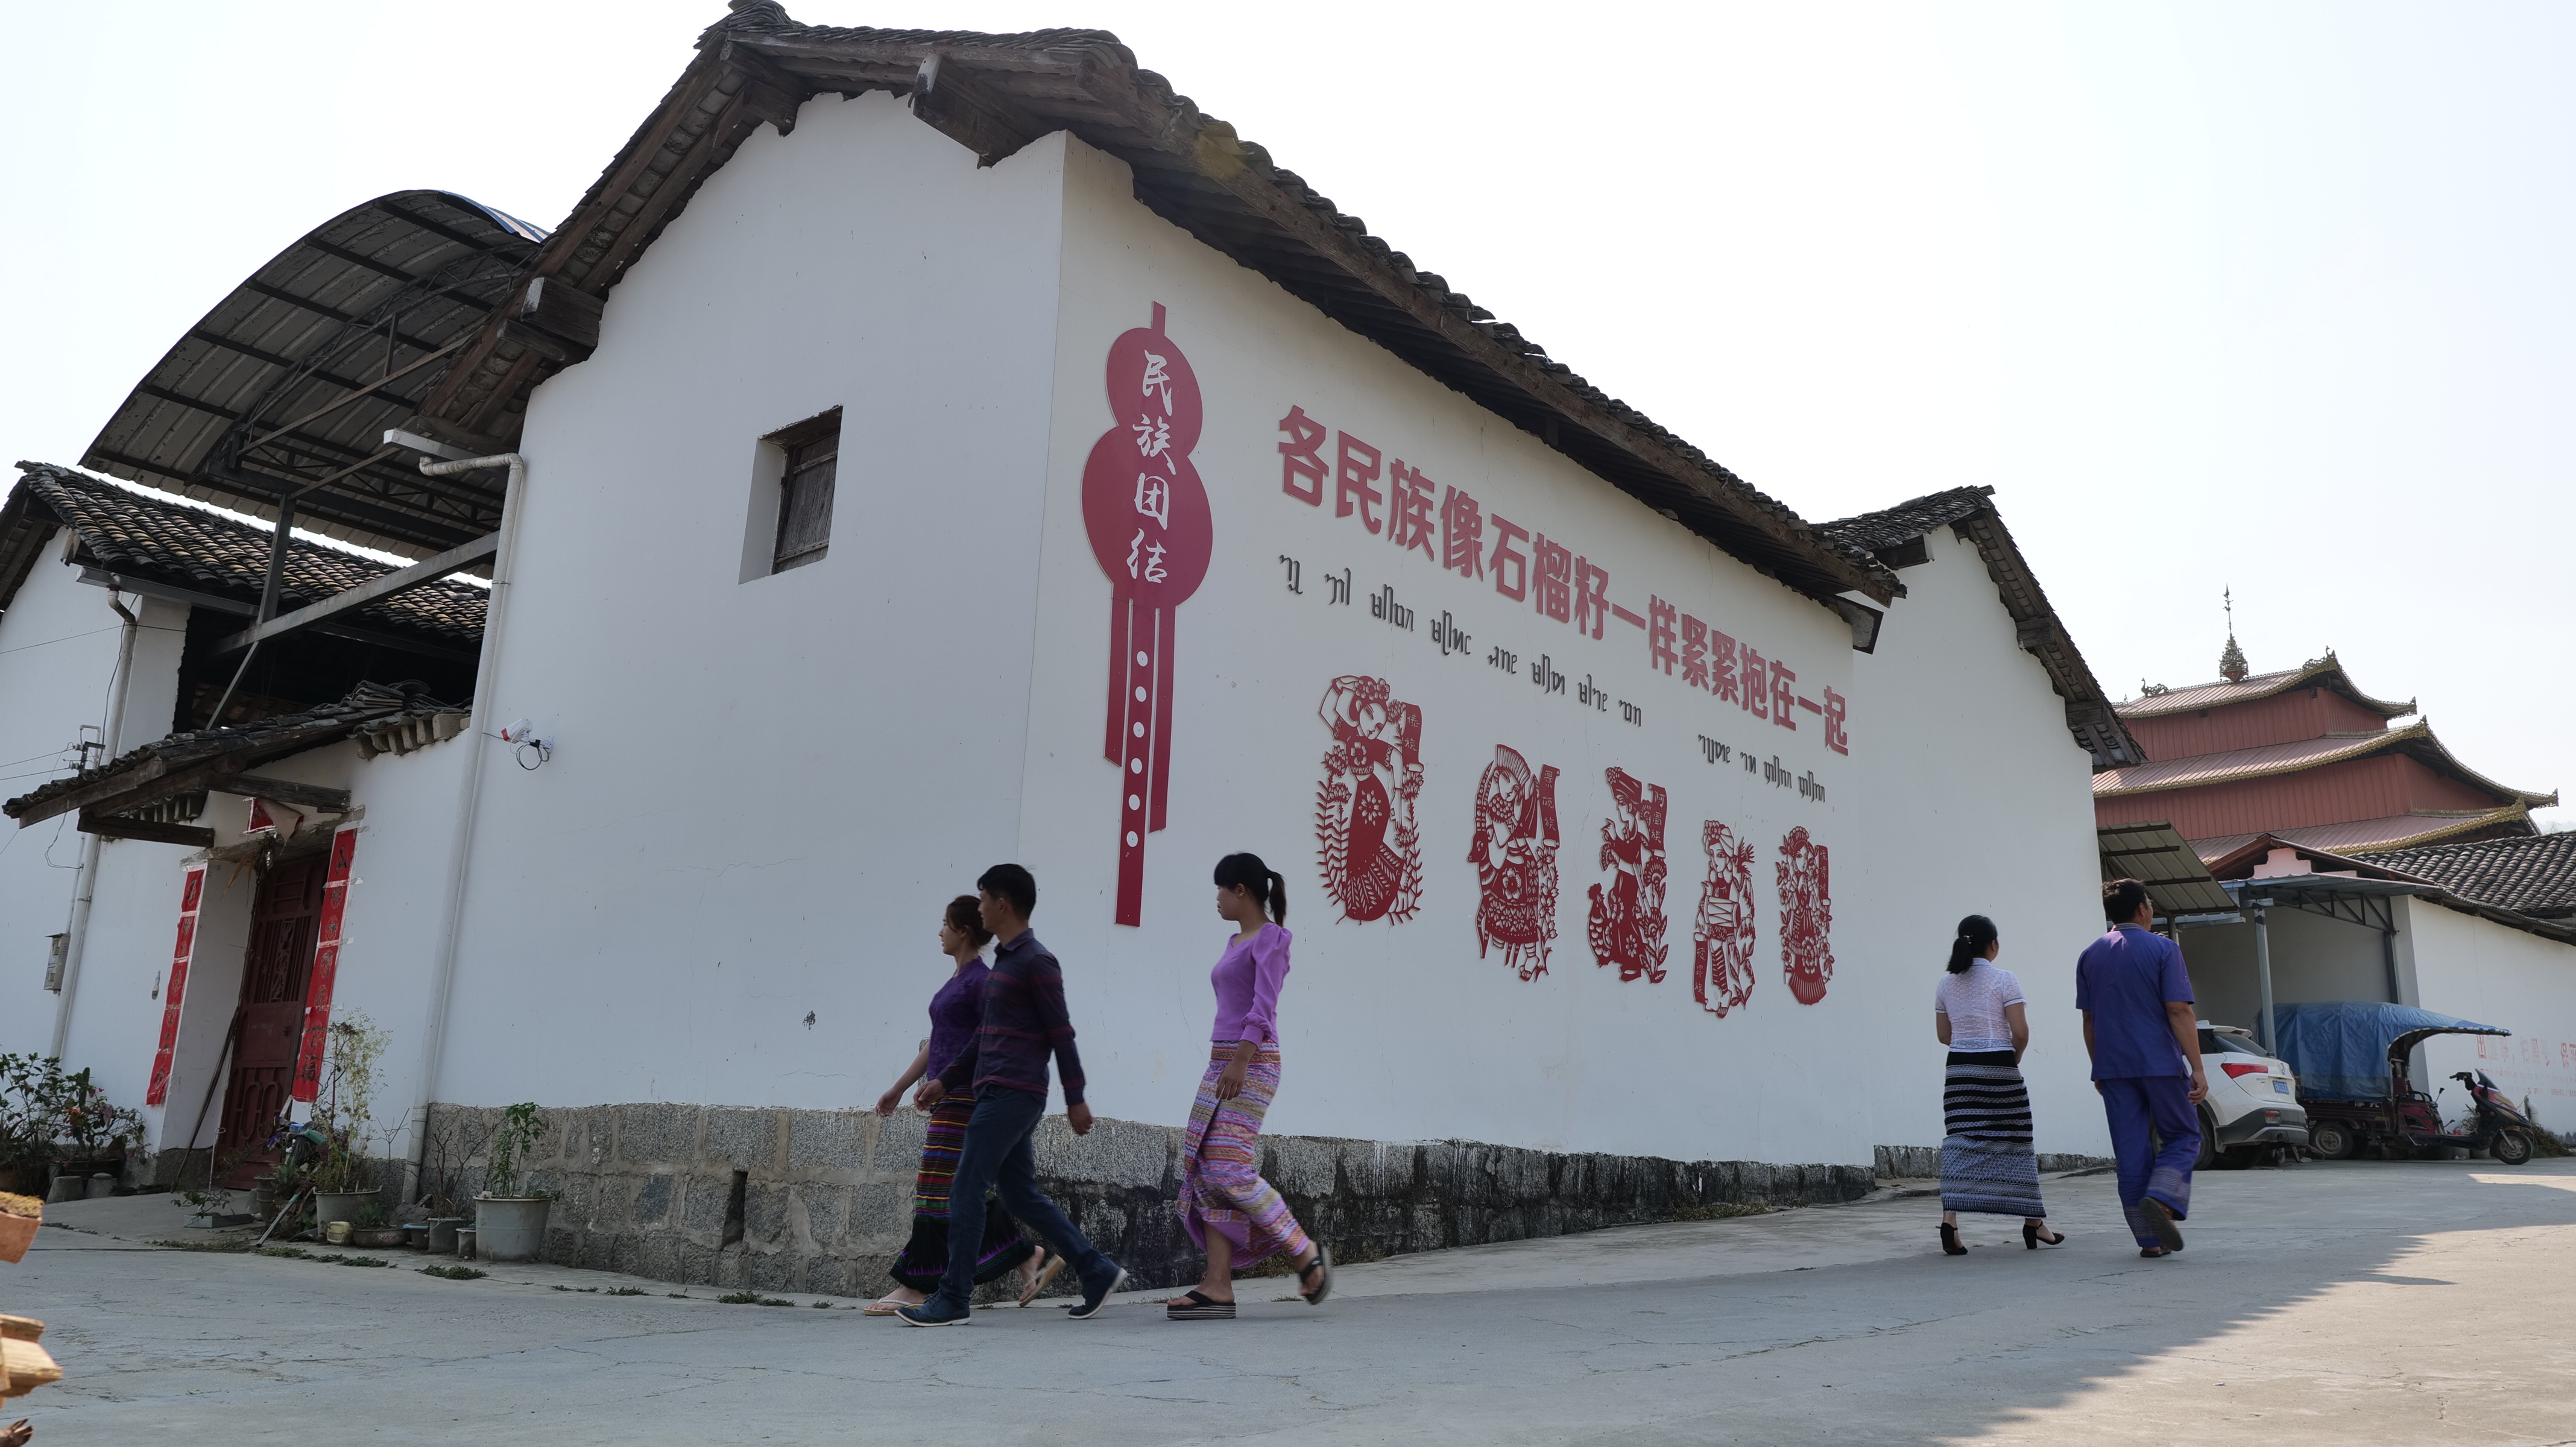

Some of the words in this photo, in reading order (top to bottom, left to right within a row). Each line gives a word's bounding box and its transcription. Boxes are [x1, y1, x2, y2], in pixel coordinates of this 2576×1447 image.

[1126, 350, 1176, 584] 民族团结
[1278, 405, 1849, 757] 各民族像石榴籽一样紧紧抱在一起
[1404, 713, 1420, 752] 傣族
[1542, 769, 1557, 831] 景颇族
[1651, 790, 1666, 843] 阿昌族
[1694, 947, 1706, 995] 德昂族
